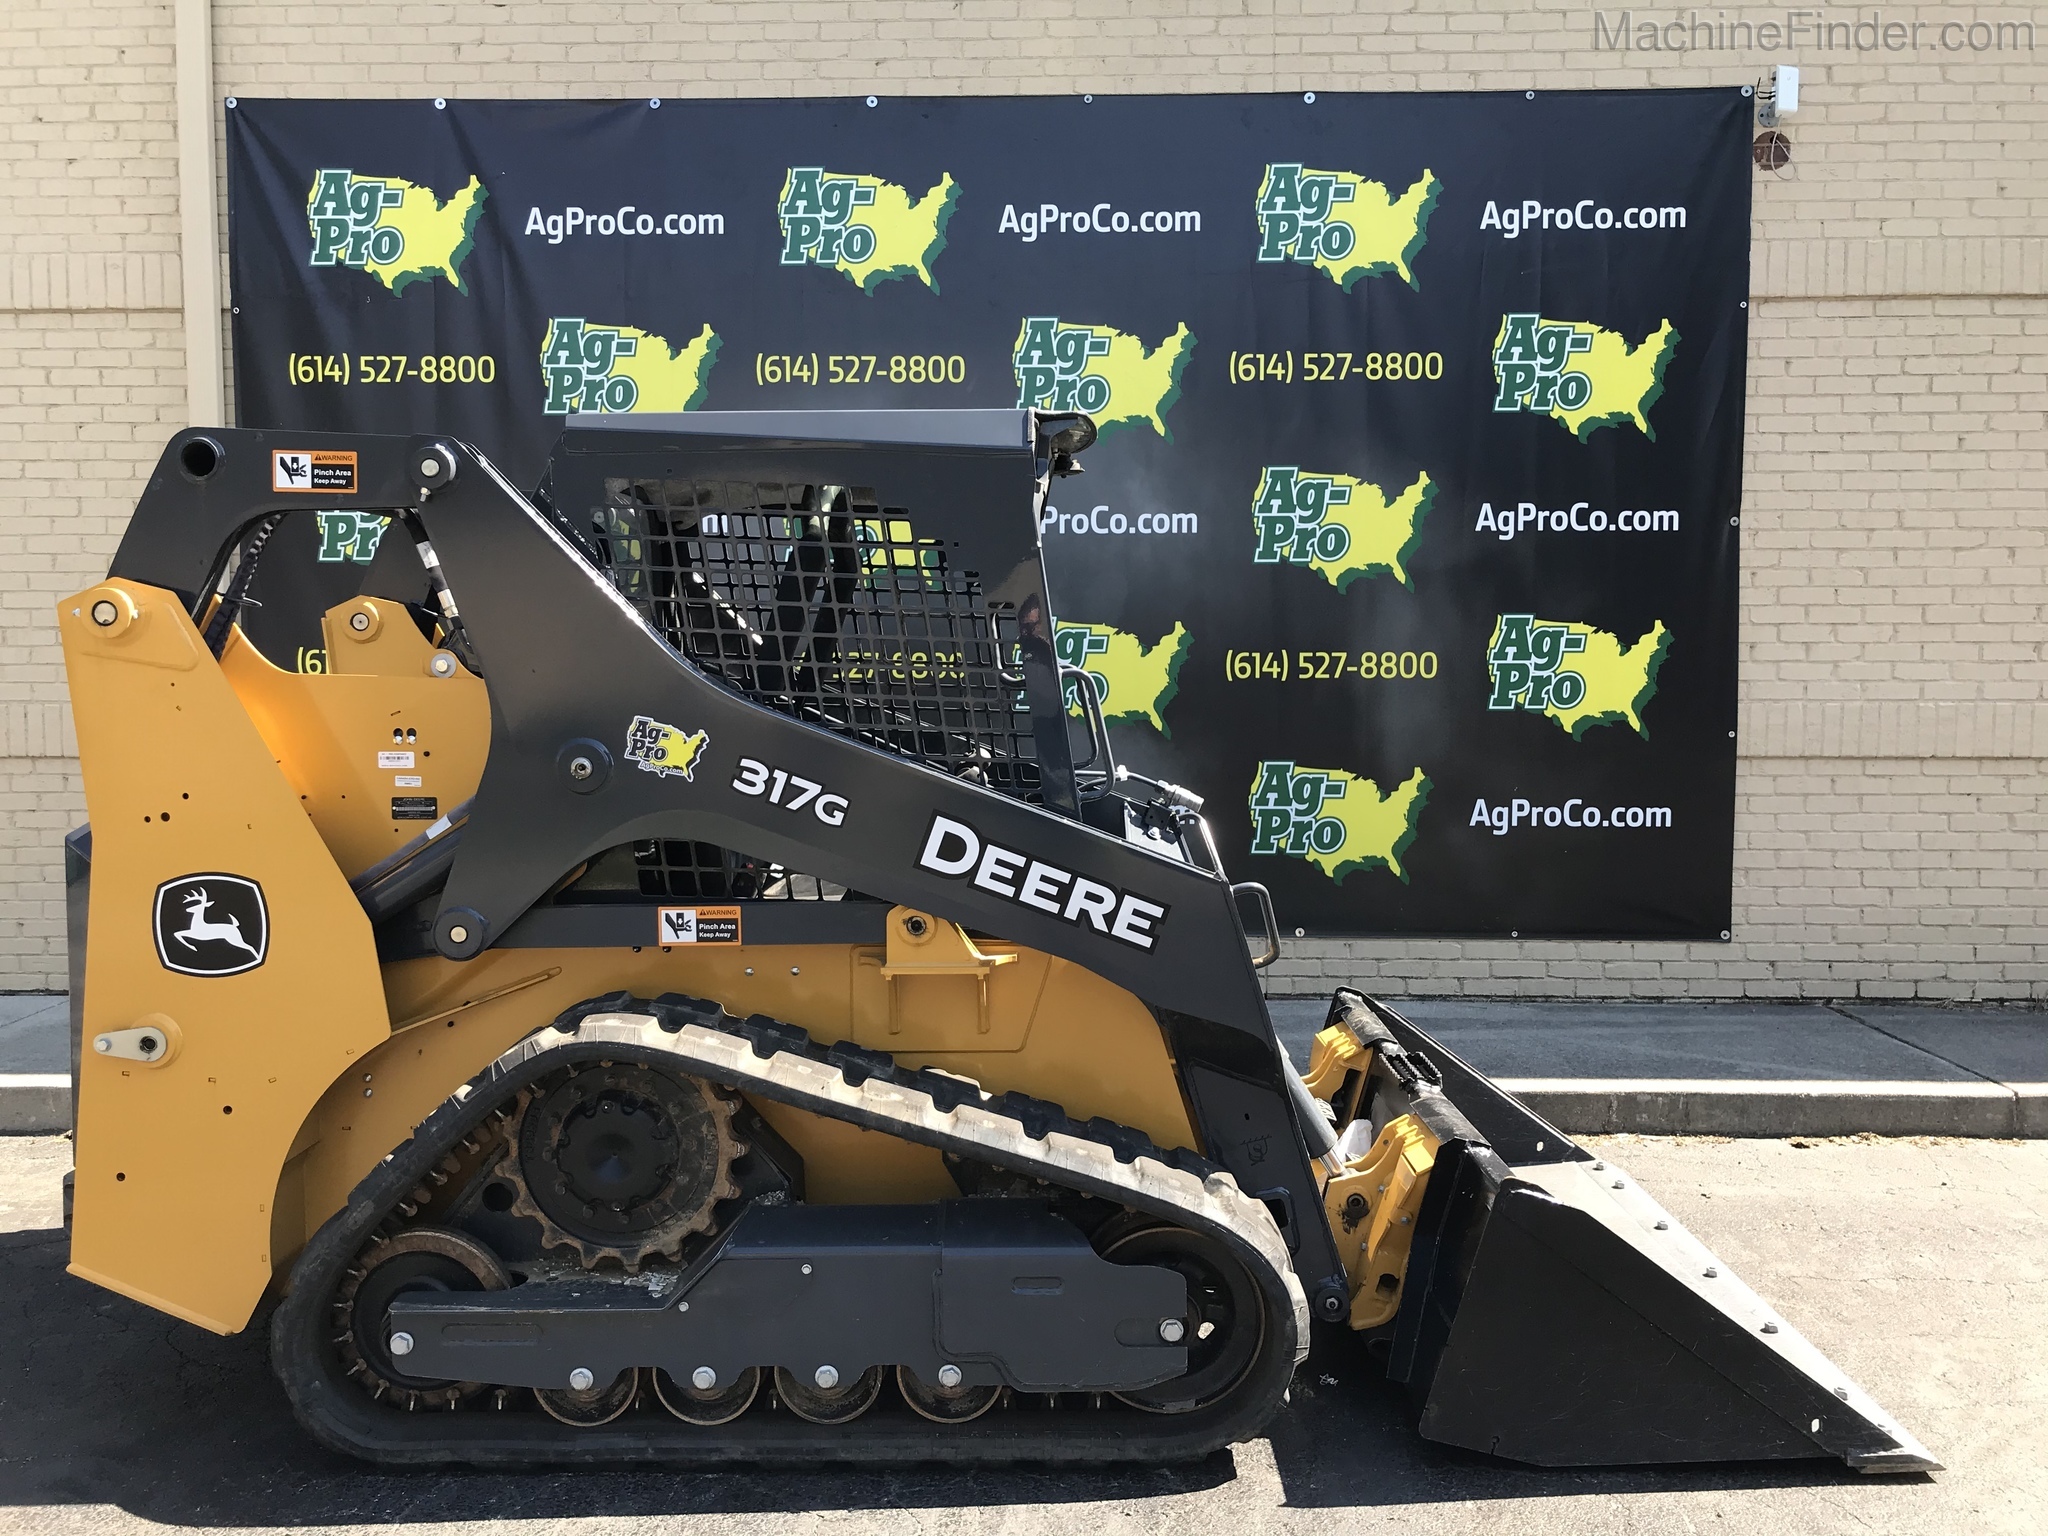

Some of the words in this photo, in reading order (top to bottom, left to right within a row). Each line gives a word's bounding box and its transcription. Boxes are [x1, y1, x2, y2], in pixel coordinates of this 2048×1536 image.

[310, 170, 403, 229] Ag-
[781, 168, 875, 226] Ag-
[1258, 164, 1355, 223] Ag-
[311, 218, 403, 265] Pro
[525, 206, 725, 245] AgProCo.com
[781, 217, 875, 264] Pro
[999, 203, 1201, 243] AgProCo.com
[1258, 213, 1354, 261] Pro
[1480, 199, 1687, 239] AgProCo.com
[543, 319, 636, 377] Ag-
[1015, 318, 1110, 377] Ag-
[1229, 351, 1293, 384] (614)
[1304, 352, 1443, 381] 527-8800
[1495, 314, 1592, 374] Ag-
[289, 353, 350, 385] (614)
[360, 355, 496, 384] 527-8800
[544, 367, 637, 414] Pro
[756, 353, 819, 386] (614)
[829, 355, 965, 383] 527-8800
[1016, 367, 1110, 413] Pro
[1495, 363, 1591, 411] Pro
[314, 468, 334, 476] Pinch
[314, 477, 329, 485] Keep
[330, 478, 347, 486] Away
[1041, 505, 1198, 534] ProCo.com
[1254, 467, 1350, 526] Ag-
[318, 511, 388, 561] Pr
[1254, 515, 1350, 562] Pro
[1475, 502, 1679, 541] AgProCo.com
[1225, 649, 1289, 681] (614)
[1300, 651, 1438, 679] 527-8800
[1489, 614, 1586, 673] Ag-
[1489, 662, 1585, 709] Pro
[628, 739, 667, 761] Pro
[631, 719, 671, 745] Ag-
[640, 761, 683, 774] AgProCo.com
[1251, 762, 1346, 818] Ag-
[732, 758, 849, 826] 317G
[1251, 808, 1345, 854] Pro
[1470, 798, 1672, 836] AgProCo.com
[919, 815, 1166, 949] DEERE
[715, 931, 731, 939] Away
